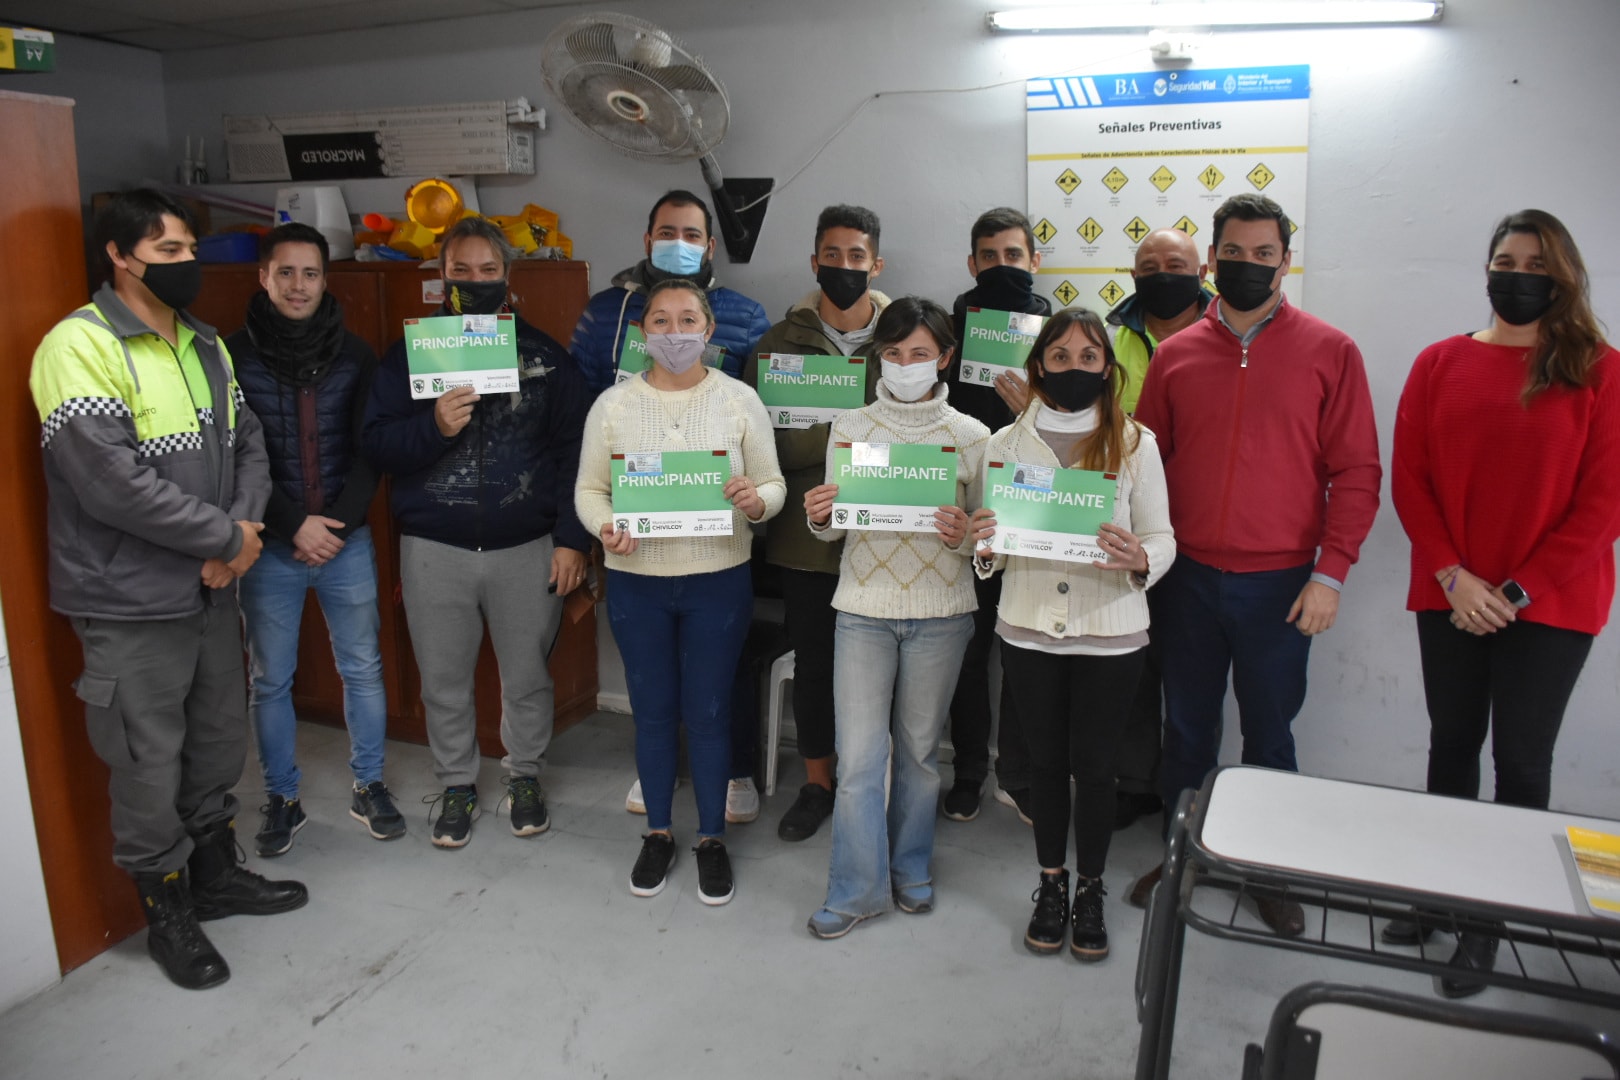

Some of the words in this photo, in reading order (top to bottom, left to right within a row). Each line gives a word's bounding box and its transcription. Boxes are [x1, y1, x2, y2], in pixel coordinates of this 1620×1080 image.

[26, 47, 44, 62] A4
[1114, 78, 1139, 95] BA
[1098, 122, 1145, 134] Señales
[1149, 119, 1222, 132] Preventivas
[301, 150, 365, 163] MACROLED
[412, 334, 508, 350] PRINCIPIANTE
[970, 326, 1036, 346] PRINCIPIA
[764, 372, 858, 386] PRINCIPIANTE
[618, 472, 722, 487] PRINCIPIANTE
[840, 464, 948, 480] PRINCIPIANTE
[992, 484, 1105, 508] PRINCIPIANTE
